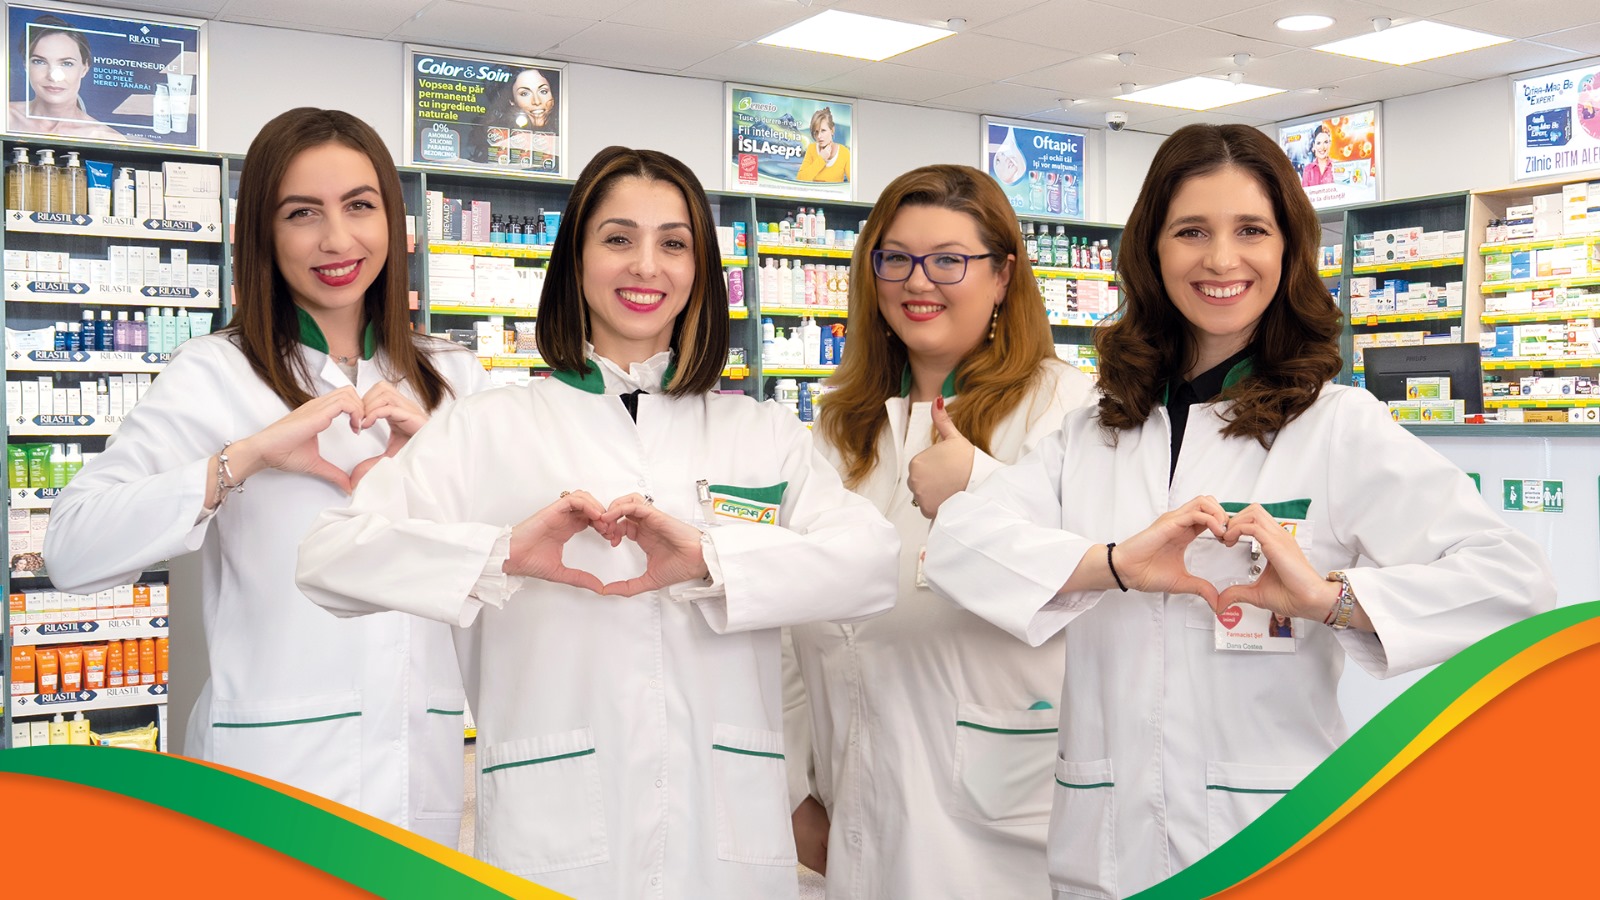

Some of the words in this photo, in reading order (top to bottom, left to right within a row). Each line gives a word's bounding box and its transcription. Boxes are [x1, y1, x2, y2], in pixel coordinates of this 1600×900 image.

[129, 34, 160, 46] RILASTIL
[93, 56, 165, 71] HYDROTENSEUR
[167, 64, 178, 72] LF
[417, 58, 463, 77] Color
[464, 66, 475, 78] &
[476, 67, 510, 83] Soin
[93, 80, 118, 88] MEREU
[418, 79, 453, 92] Vopsea
[455, 83, 467, 92] de
[468, 84, 485, 94] păr
[418, 90, 477, 103] permanentă
[431, 100, 486, 114] ingrediente
[418, 110, 459, 121] naturale
[738, 113, 754, 122] Tuse
[432, 123, 449, 133] 0%
[738, 125, 750, 135] Fii
[793, 131, 801, 141] ia
[428, 132, 454, 140] AMONIAC
[738, 135, 802, 159] iSLAsept
[1033, 135, 1078, 154] Oftapic
[1525, 154, 1552, 173] Zilnic
[1555, 150, 1578, 169] RITM
[1582, 146, 1600, 165] ALE
[37, 212, 73, 223] RILASTIL
[102, 216, 135, 226] RILASTIL
[162, 219, 194, 230] RILASTIL
[34, 281, 70, 292] RILASTIL
[99, 284, 132, 294] RILASTIL
[159, 286, 191, 297] RILASTIL
[35, 350, 70, 360] RILASTIL
[100, 351, 133, 361] RILASTIL
[40, 414, 75, 424] RILASTIL
[104, 415, 126, 423] RILA
[42, 488, 62, 497] RILA
[44, 623, 79, 633] RILASTIL
[108, 619, 141, 628] RILASTIL
[42, 692, 77, 702] RILASTIL
[106, 687, 139, 697] RILASTIL
